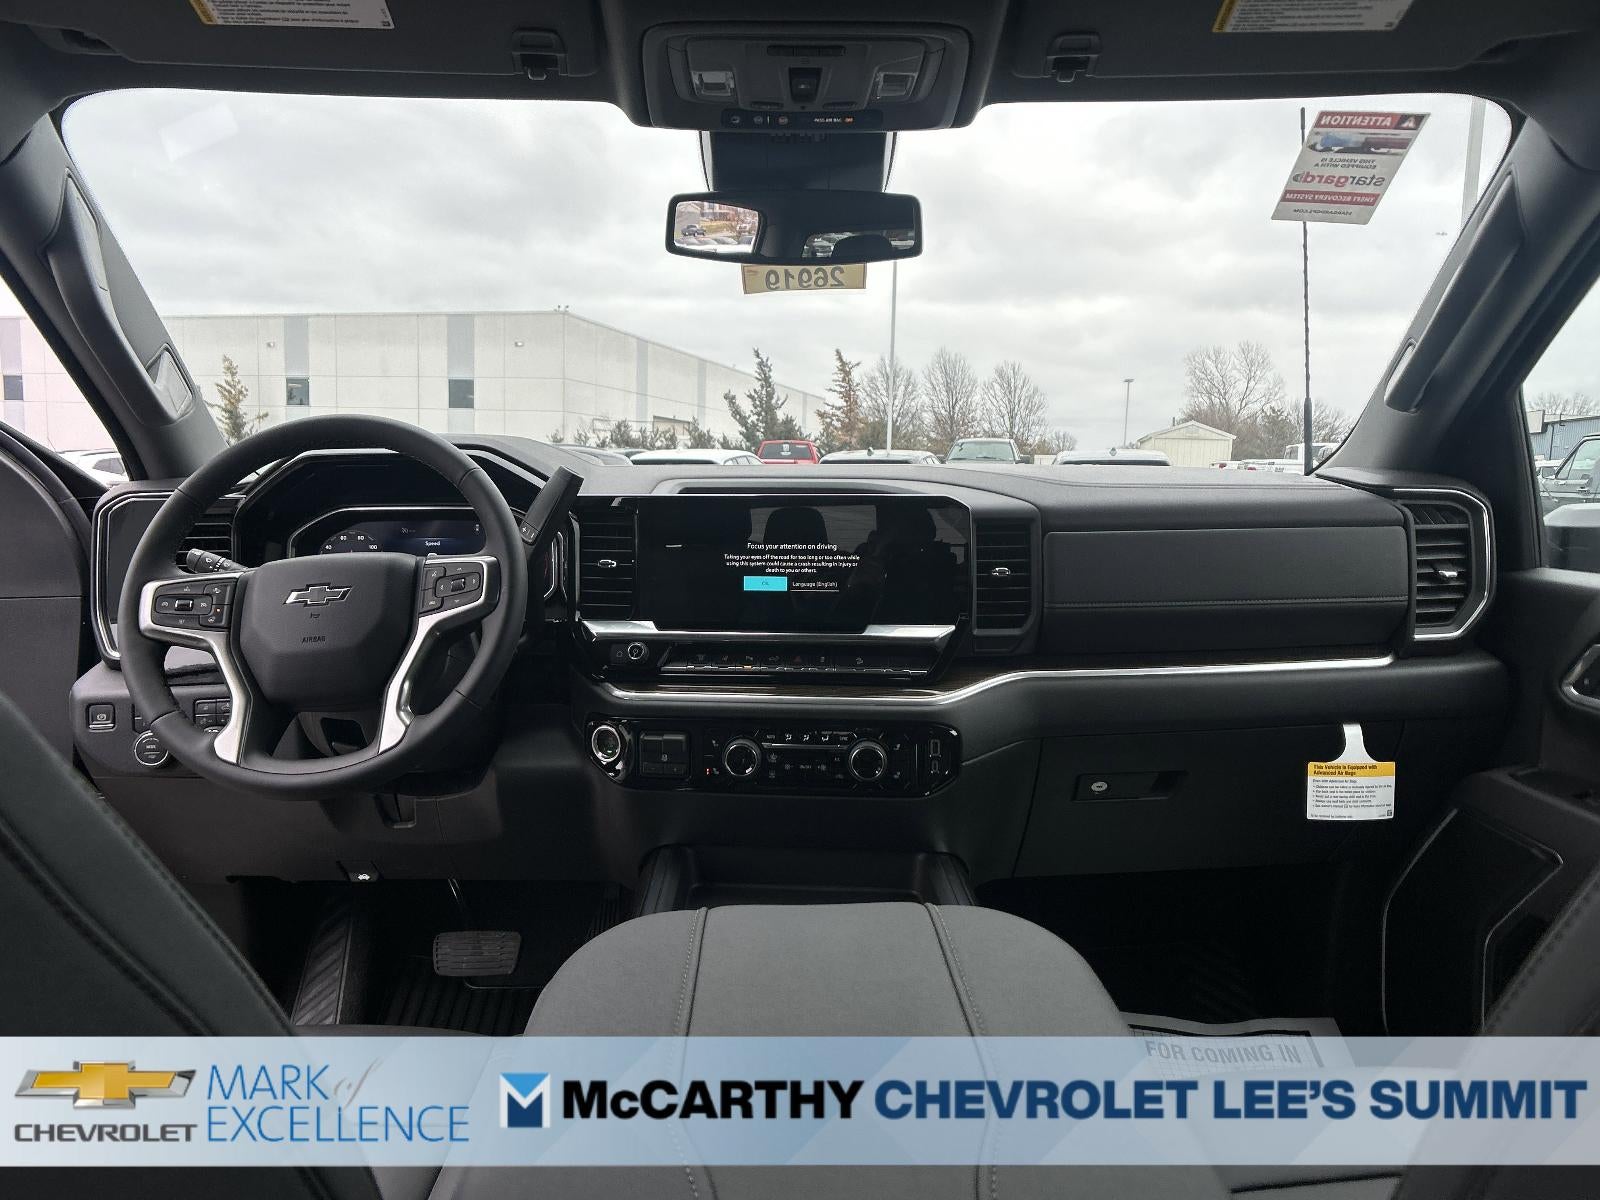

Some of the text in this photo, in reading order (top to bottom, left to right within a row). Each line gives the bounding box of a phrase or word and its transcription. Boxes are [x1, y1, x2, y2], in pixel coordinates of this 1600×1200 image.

[747, 542, 765, 550] Focus
[816, 542, 838, 551] driving
[302, 635, 326, 643] AIRBAG
[1145, 1040, 1302, 1065] FOR COMING IN
